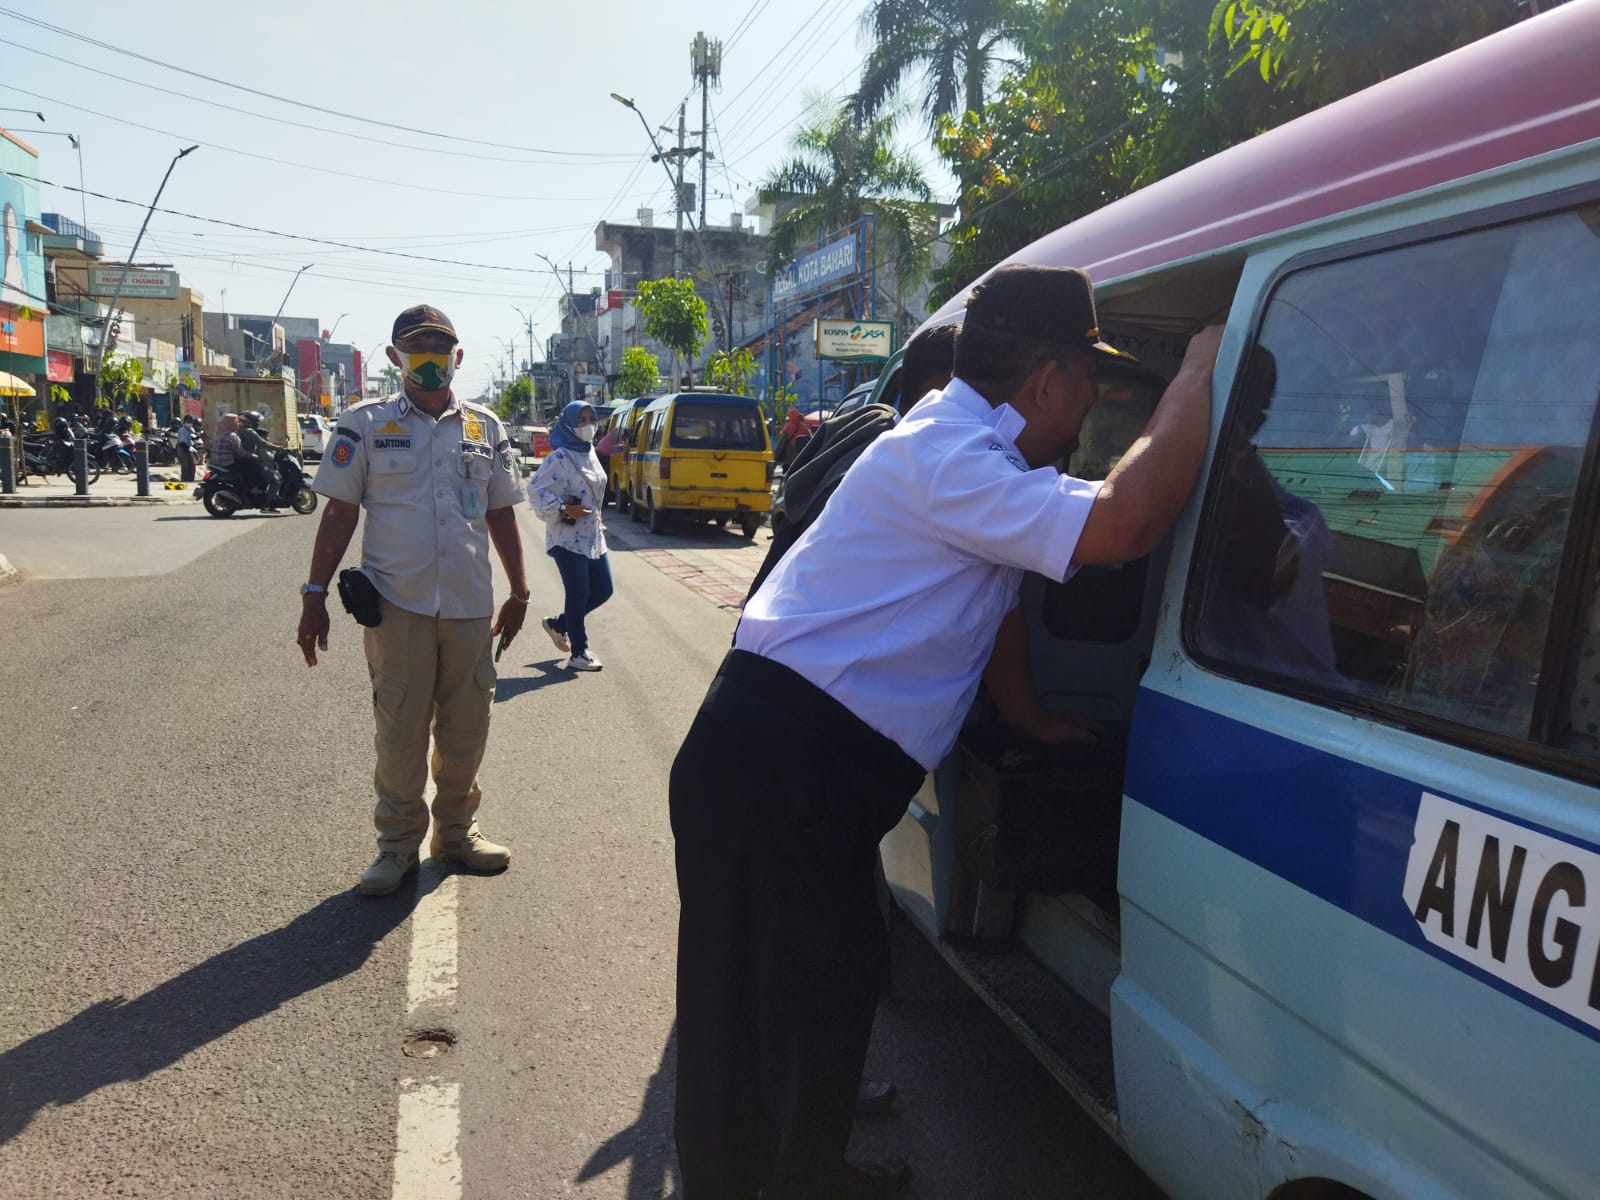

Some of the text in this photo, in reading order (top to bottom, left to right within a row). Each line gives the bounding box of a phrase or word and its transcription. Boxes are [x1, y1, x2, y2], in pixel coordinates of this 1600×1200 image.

[798, 258, 819, 285] KOTA
[821, 242, 854, 277] BAHARI
[824, 328, 849, 336] KOSPIN
[375, 439, 411, 449] SARTONO
